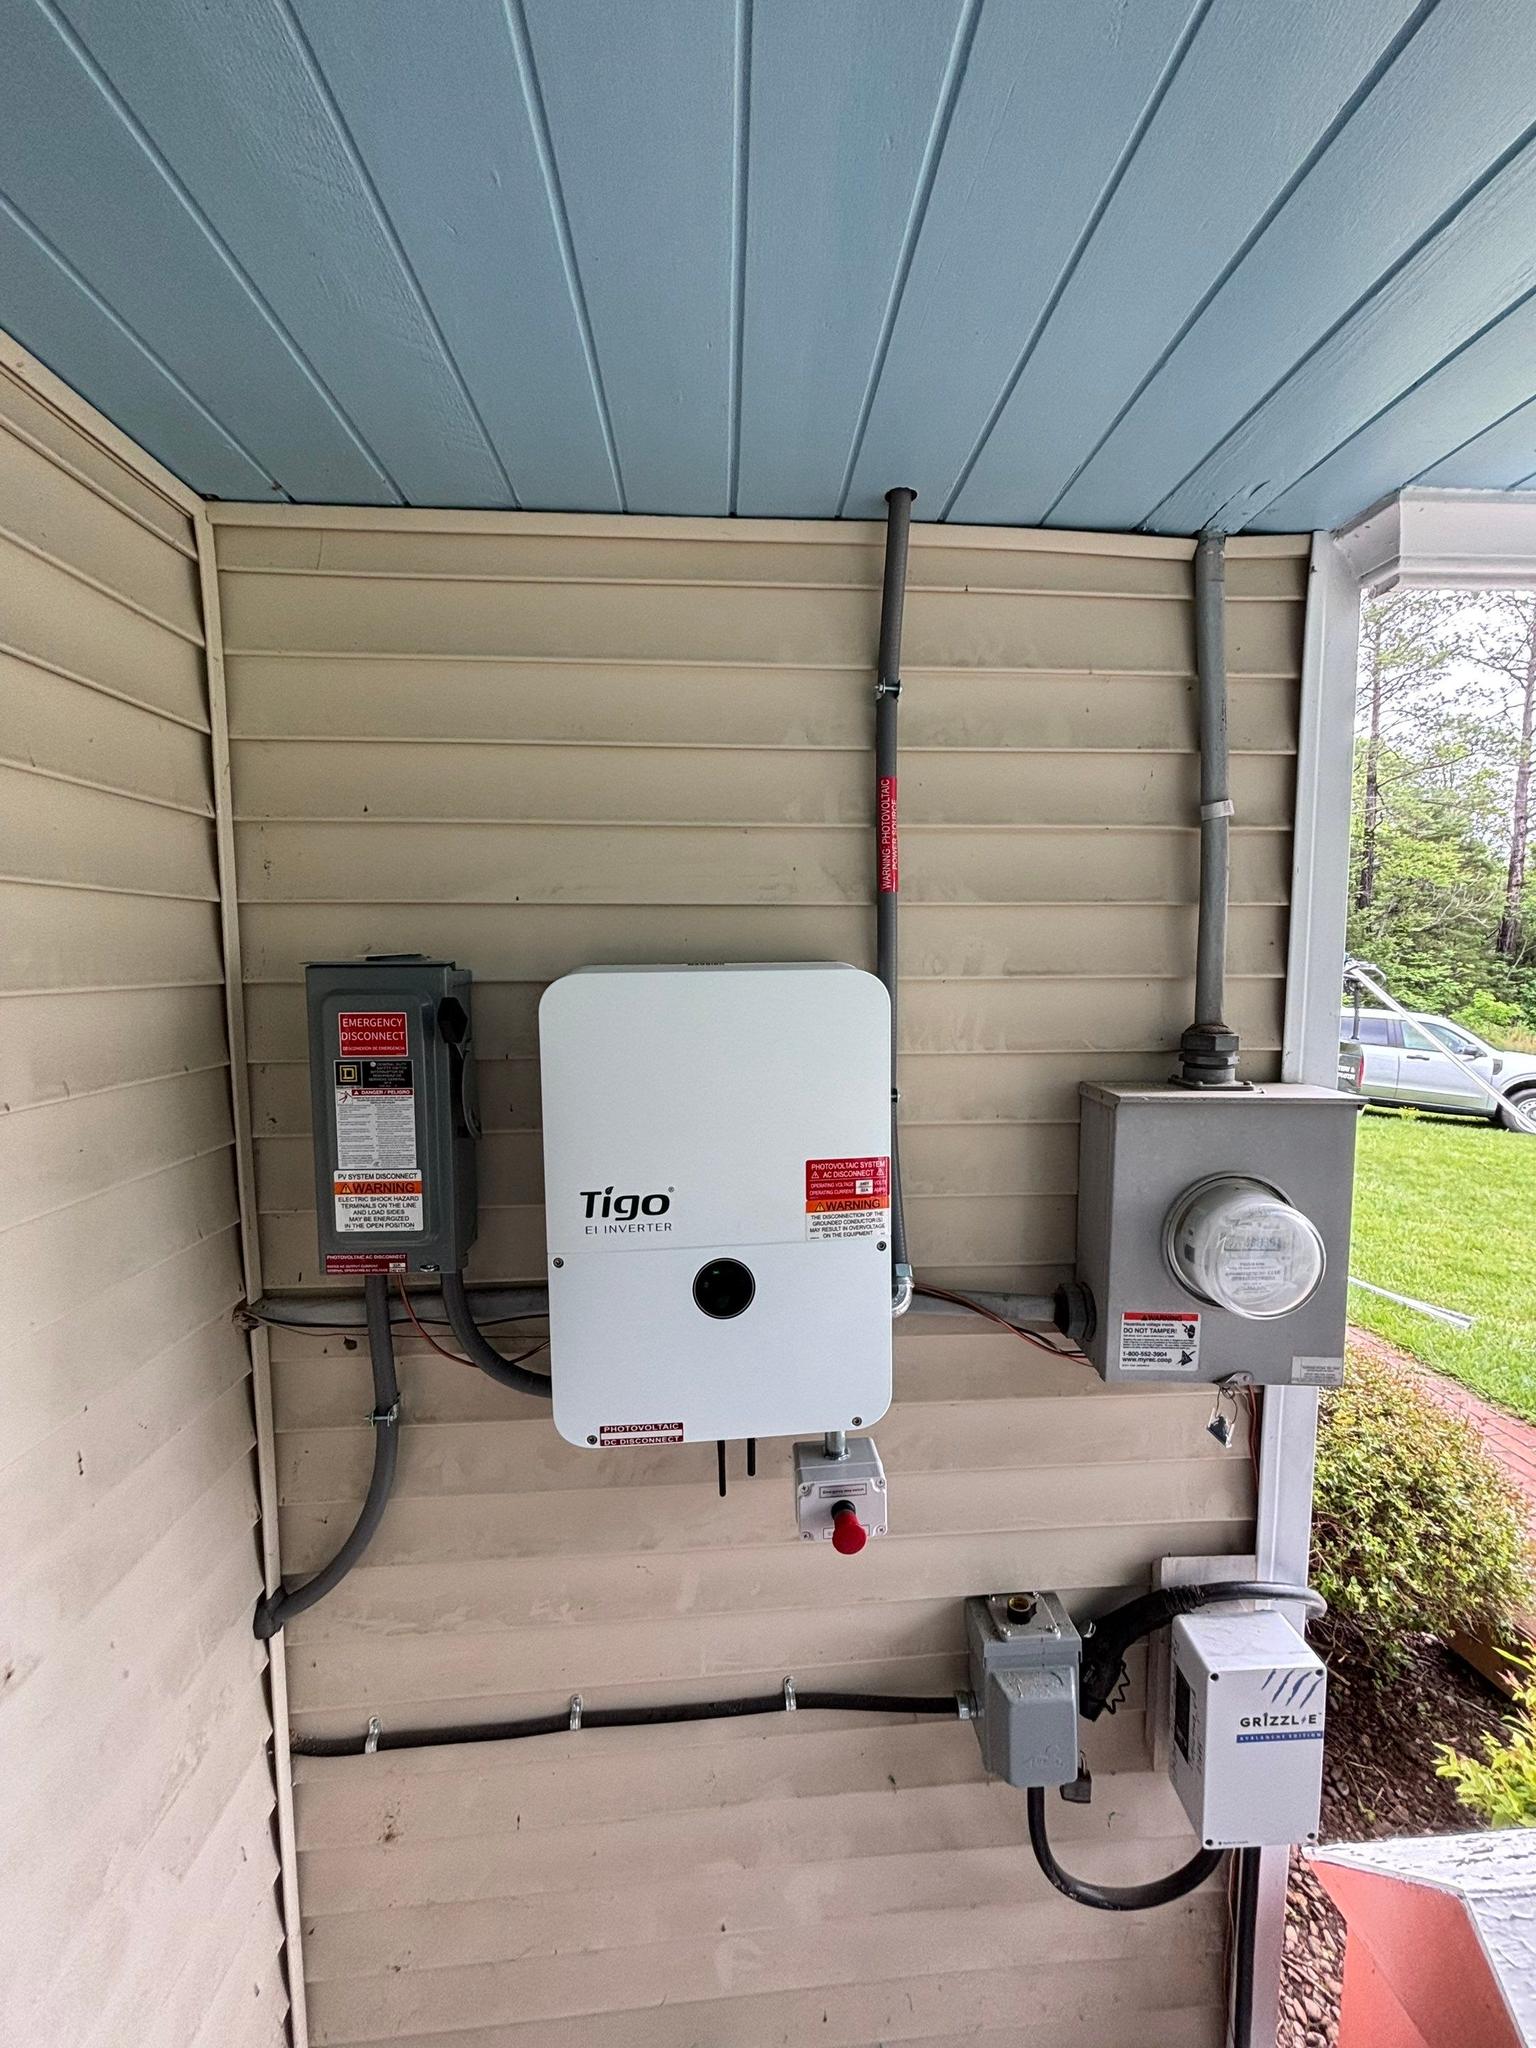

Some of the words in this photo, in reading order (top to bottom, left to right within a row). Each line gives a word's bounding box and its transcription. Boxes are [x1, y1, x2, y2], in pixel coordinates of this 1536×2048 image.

[881, 779, 891, 845] PHOTOVOLTAIC
[342, 1018, 403, 1028] EMERGENCY
[341, 1031, 405, 1041] DISCONNECT
[811, 1162, 859, 1170] PHOTOVOLTAIC
[860, 1160, 885, 1169] SYSTEM
[375, 1172, 418, 1180] DISCONNECT
[833, 1169, 875, 1178] DISCONNECT
[353, 1182, 415, 1194] WARNING
[580, 1186, 670, 1221] Tigo
[826, 1199, 880, 1211] WARNING
[604, 1222, 672, 1234] INVERTER
[849, 1223, 886, 1231] OVERVOLTAGE
[843, 1230, 873, 1238] EQUIPMENT
[603, 1423, 679, 1433] PHOTOVOLTAIC
[619, 1436, 679, 1445] DISCONNECT
